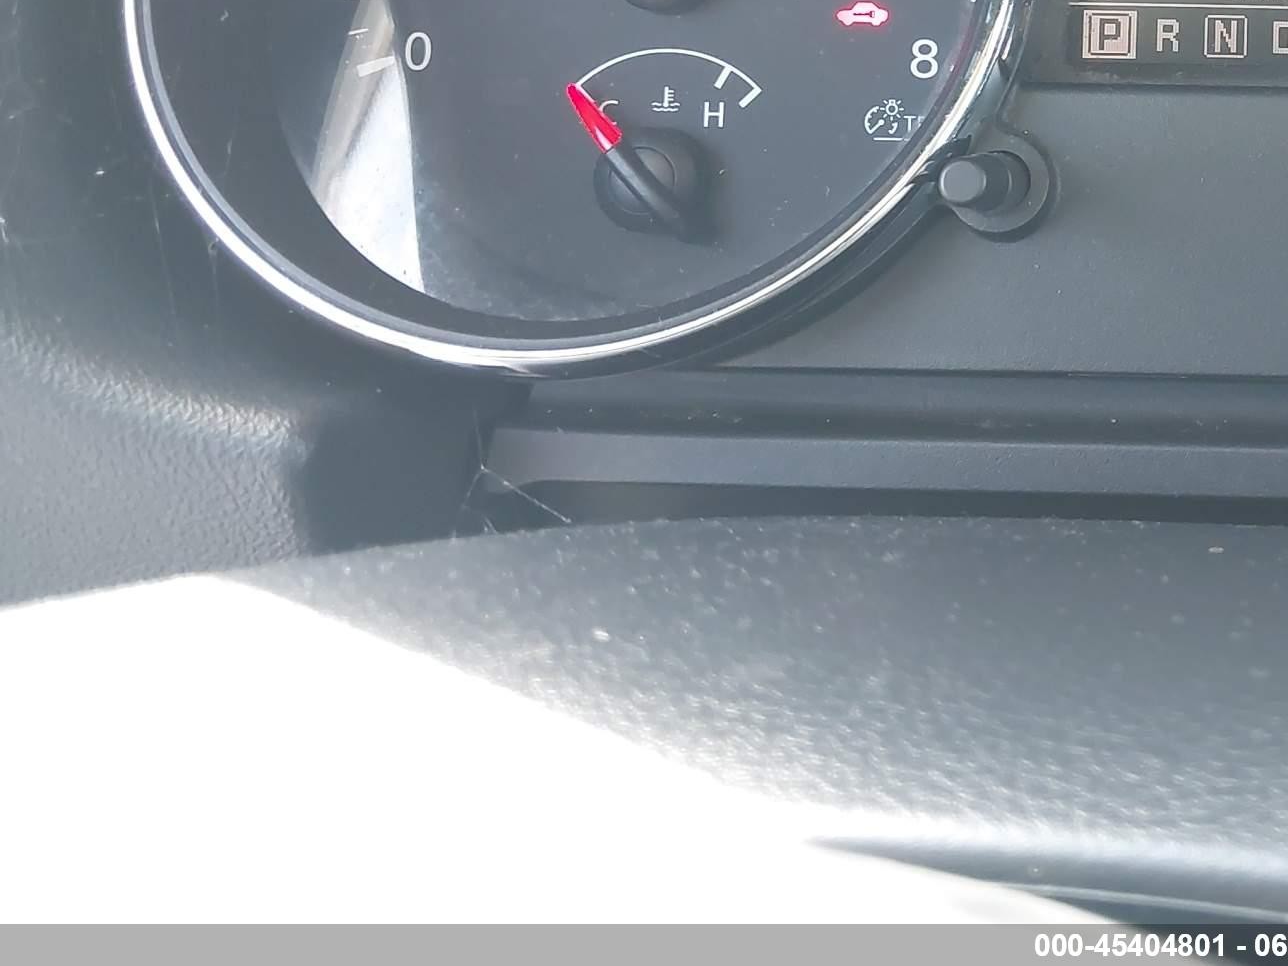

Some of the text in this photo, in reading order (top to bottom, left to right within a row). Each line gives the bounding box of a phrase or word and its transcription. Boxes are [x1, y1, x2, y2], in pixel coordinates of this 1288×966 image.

[404, 32, 432, 72] 0
[1098, 18, 1121, 52] P
[1156, 19, 1180, 52] R
[1213, 20, 1238, 52] N
[911, 39, 939, 79] 8
[702, 102, 725, 128] H
